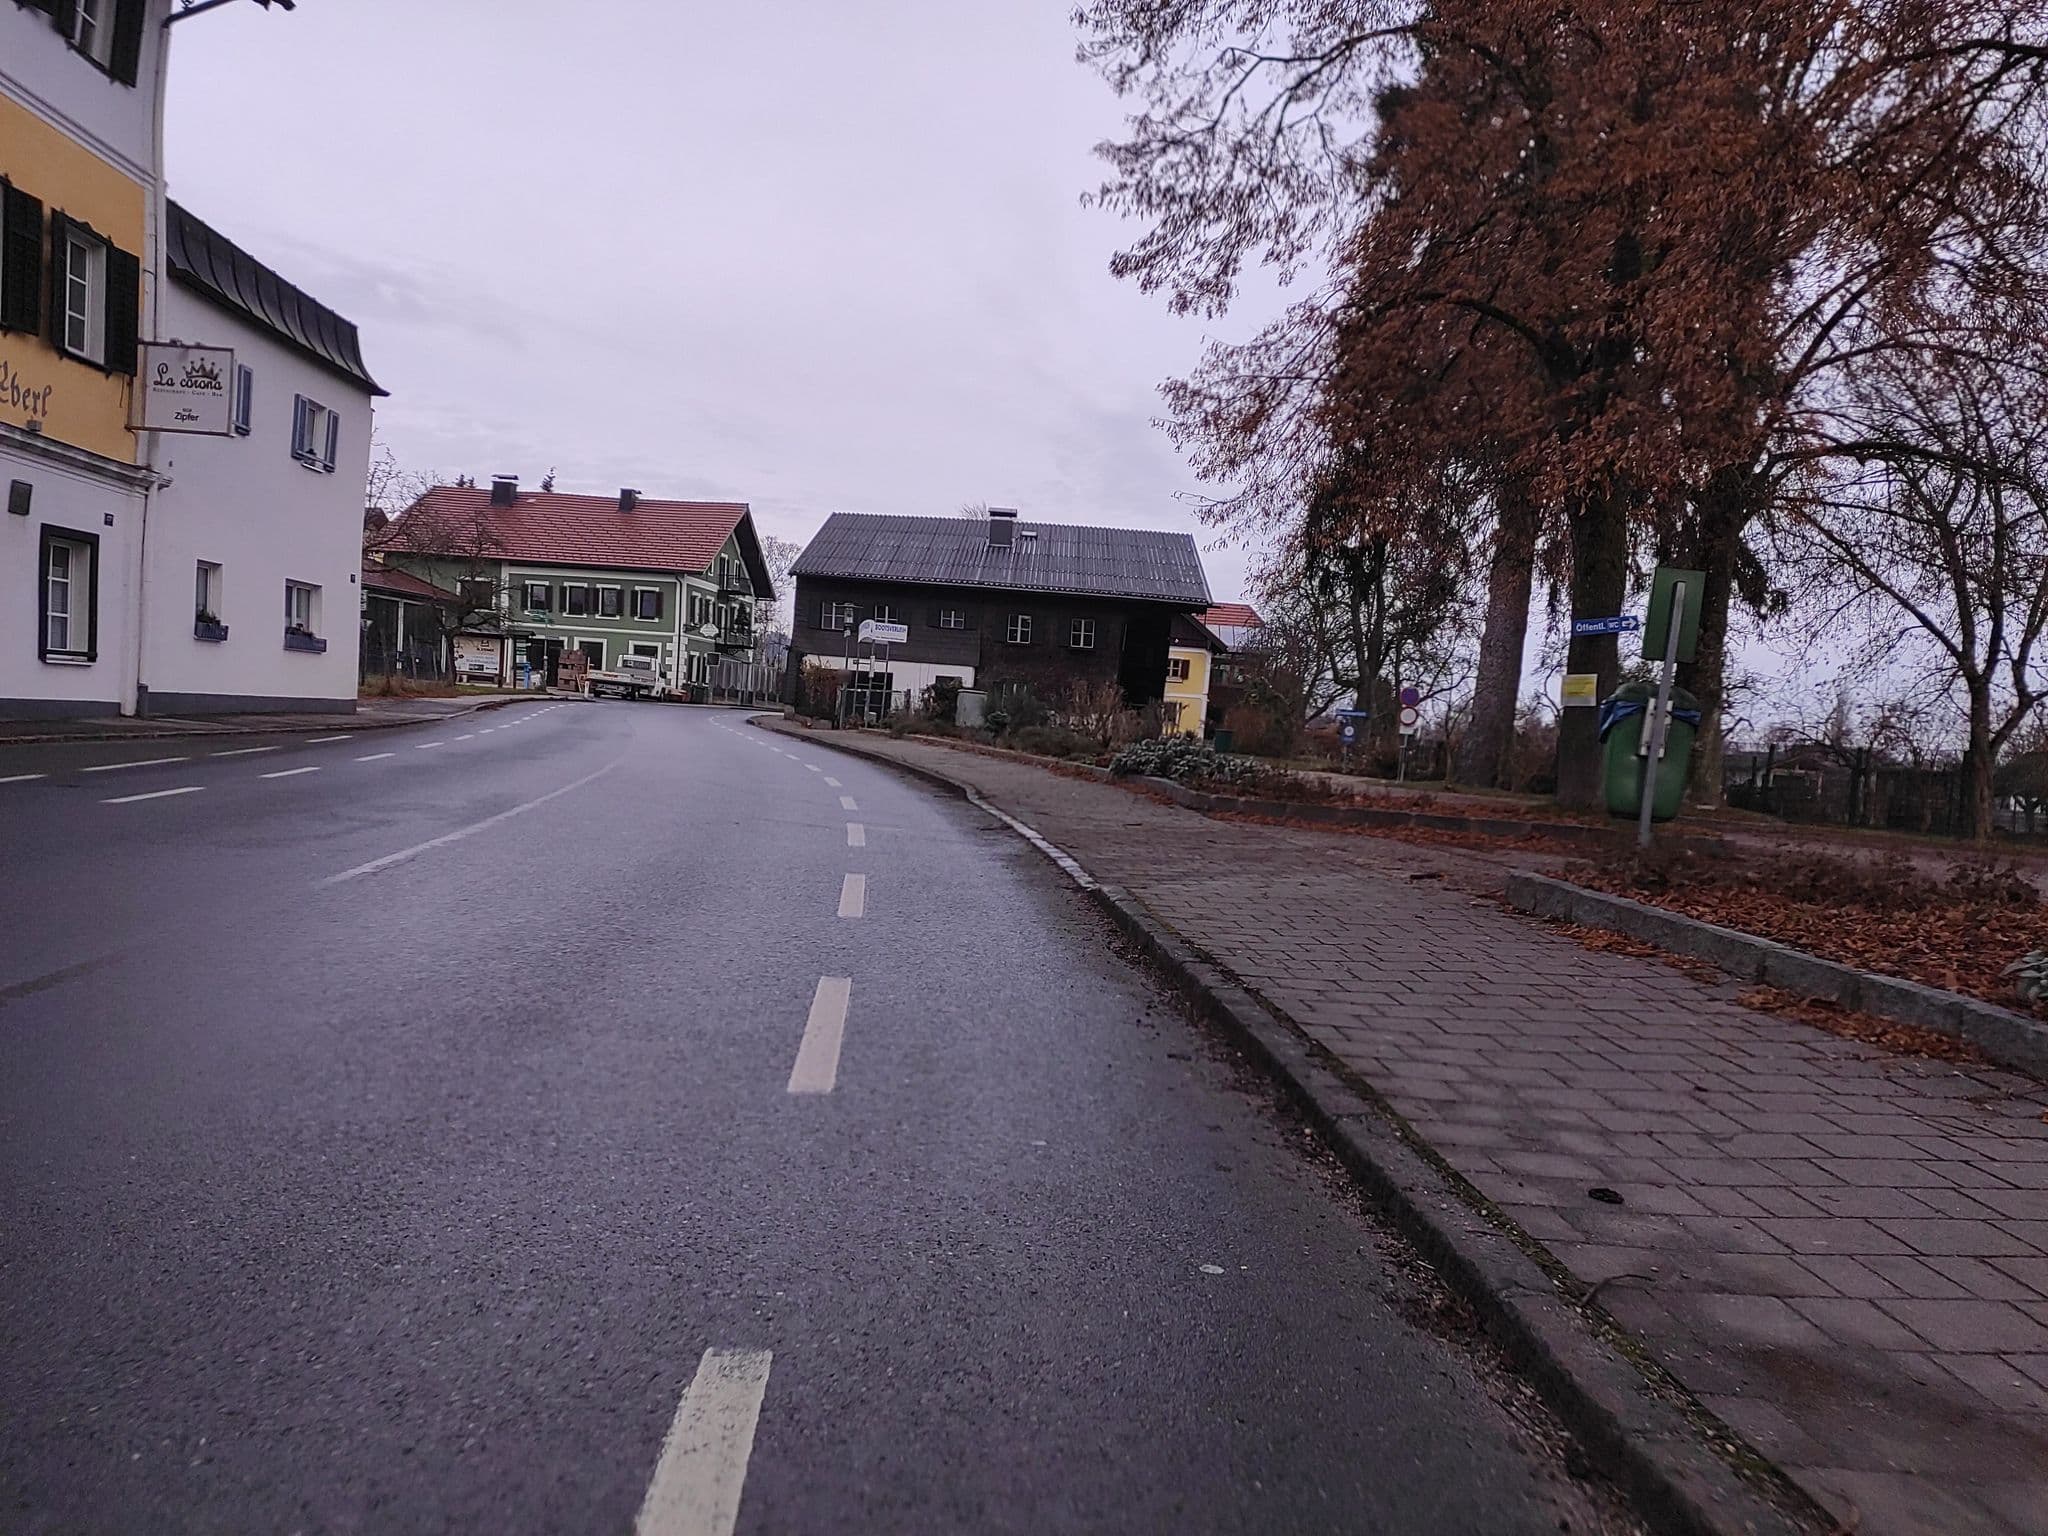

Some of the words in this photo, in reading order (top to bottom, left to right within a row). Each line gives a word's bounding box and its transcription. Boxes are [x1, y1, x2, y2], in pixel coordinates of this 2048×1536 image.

[153, 362, 176, 387] La
[180, 377, 223, 391] corona
[174, 411, 200, 423] Zipfer
